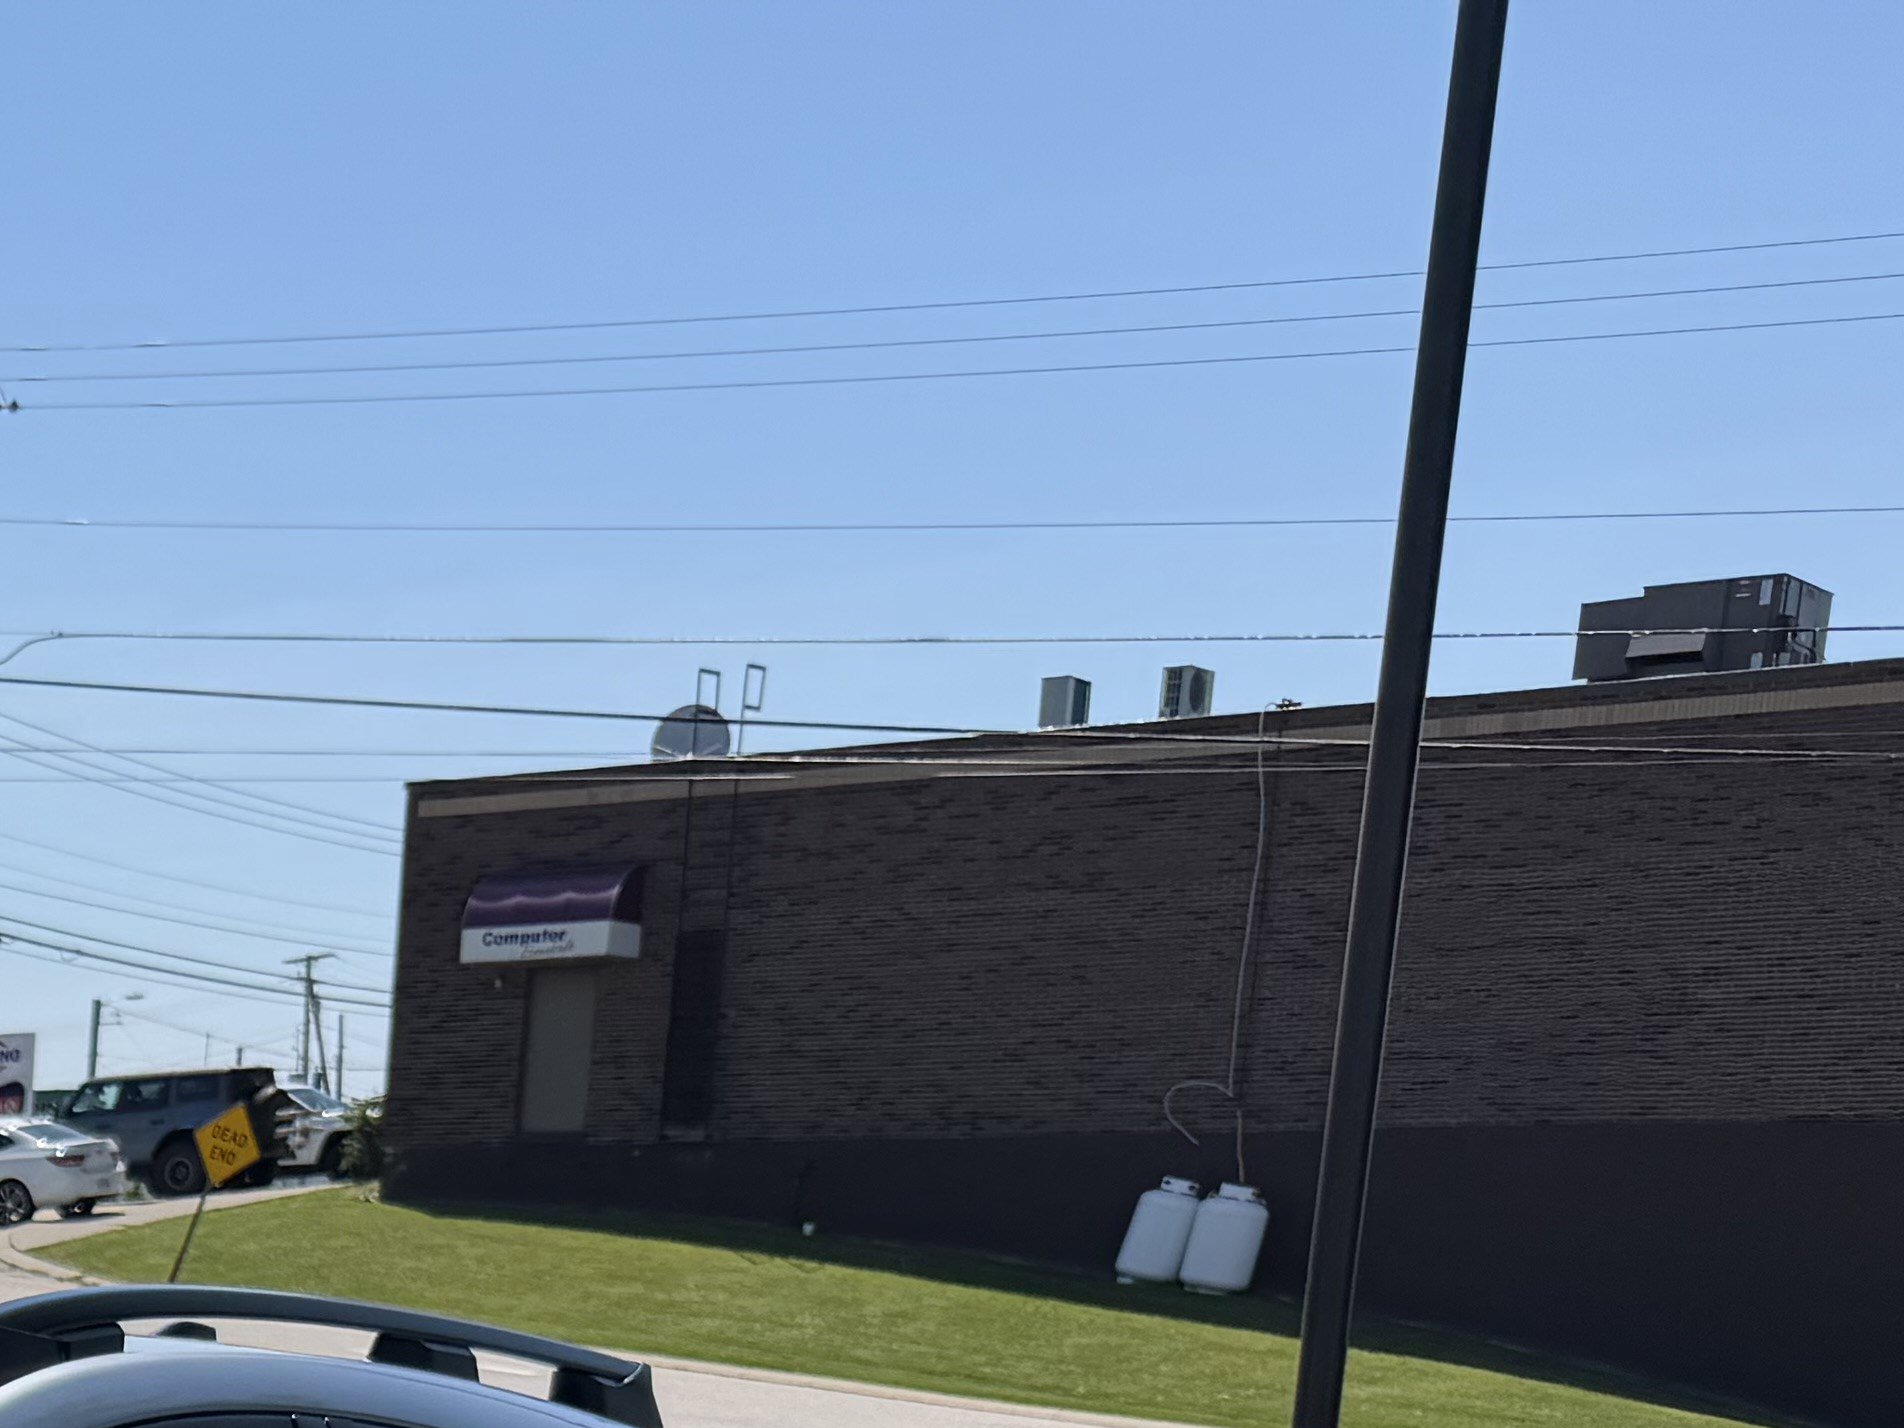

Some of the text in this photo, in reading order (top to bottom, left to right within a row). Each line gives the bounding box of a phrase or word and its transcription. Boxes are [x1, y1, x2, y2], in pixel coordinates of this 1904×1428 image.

[482, 929, 566, 948] Computer
[212, 1124, 248, 1149] DEAD
[210, 1145, 236, 1166] END
